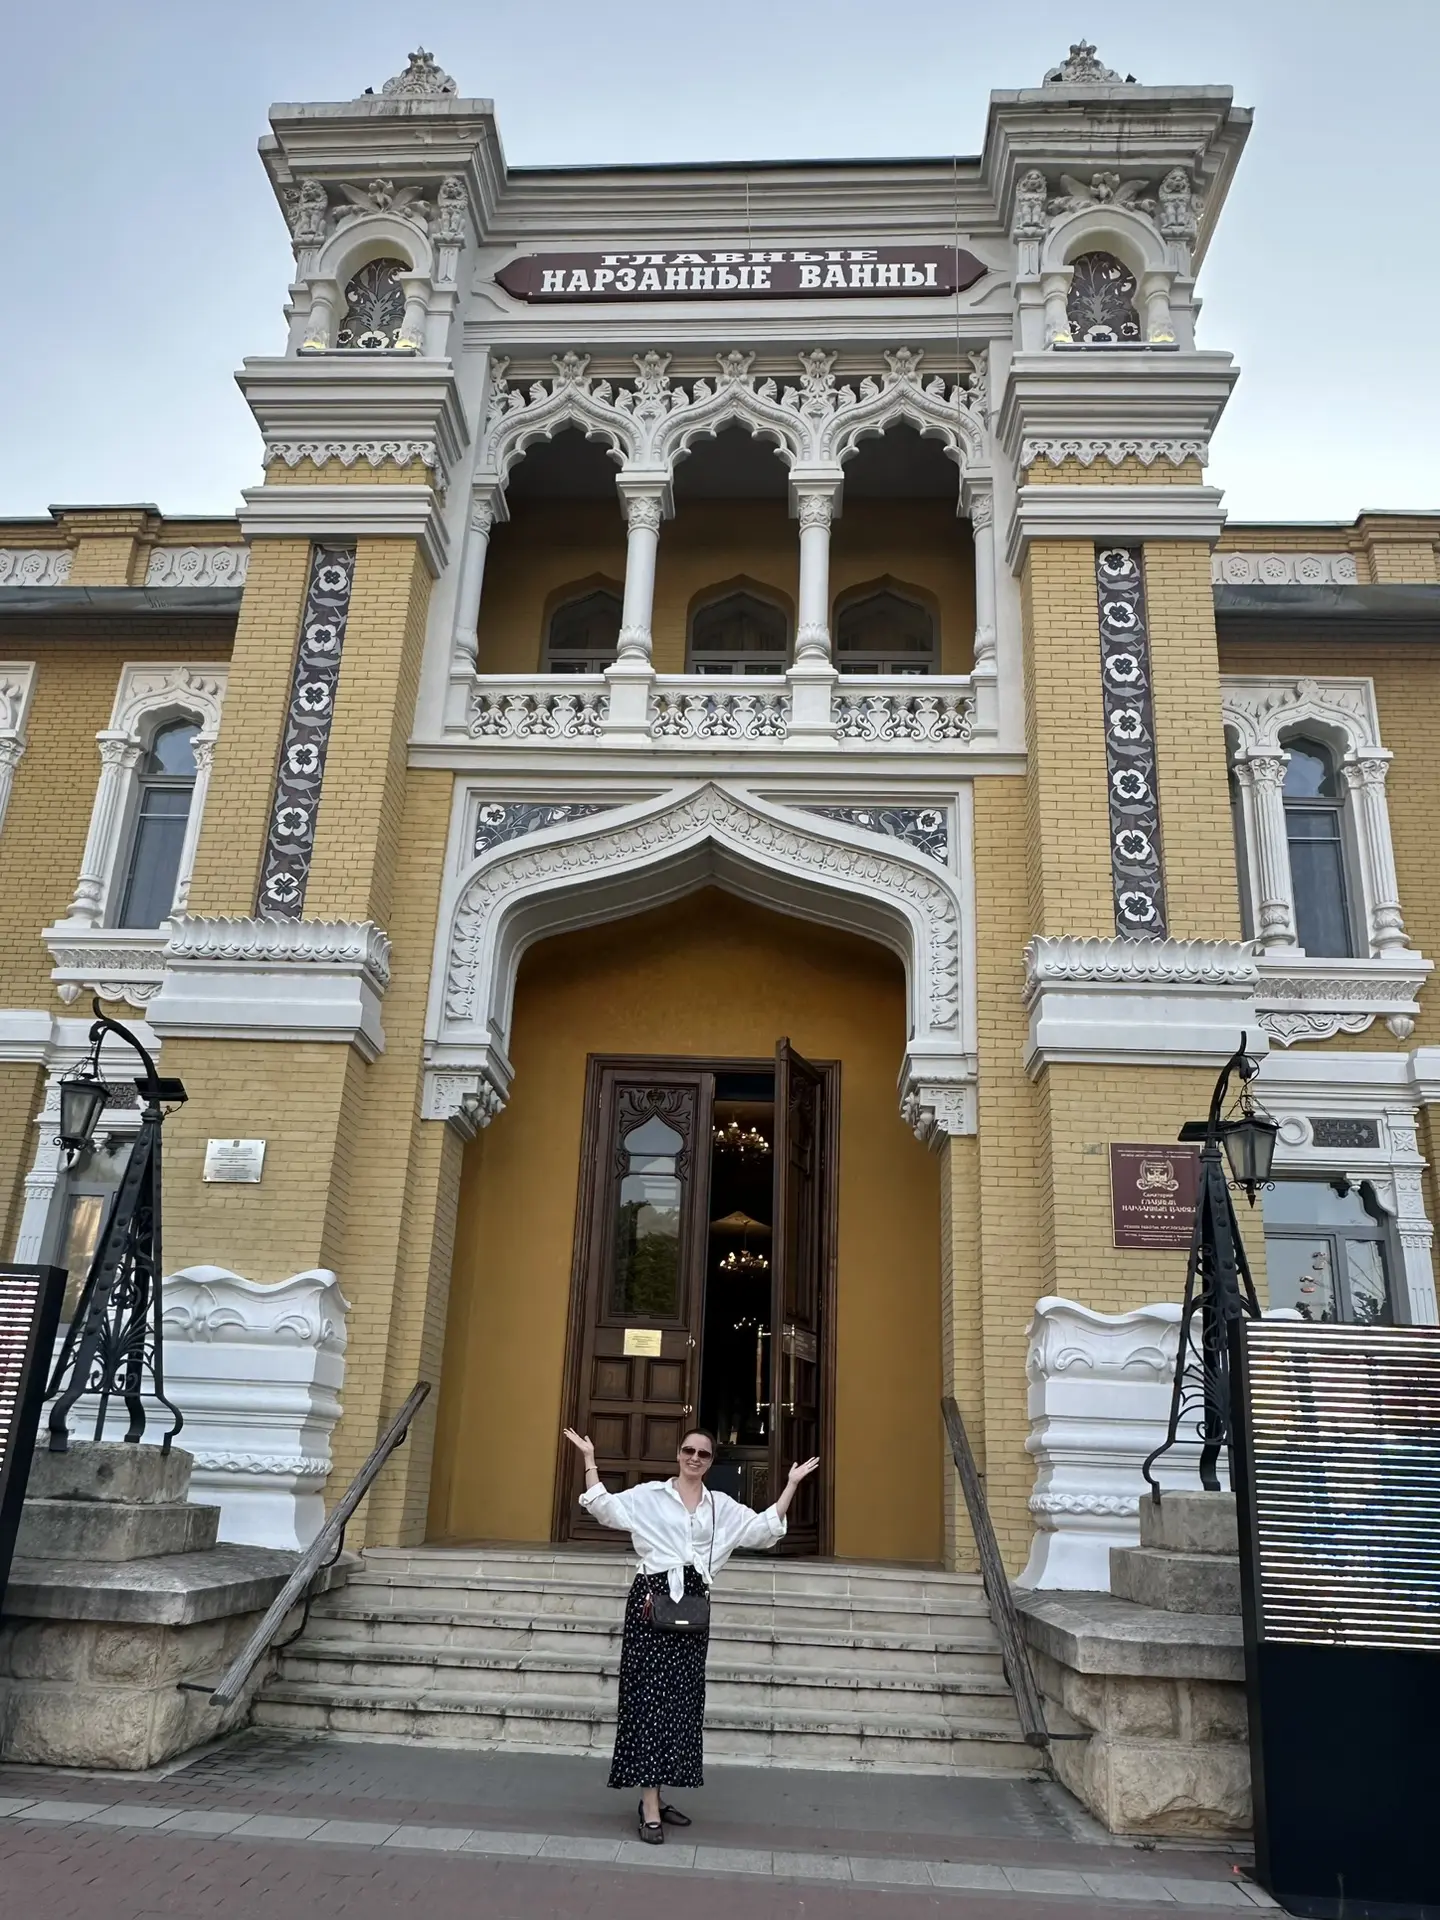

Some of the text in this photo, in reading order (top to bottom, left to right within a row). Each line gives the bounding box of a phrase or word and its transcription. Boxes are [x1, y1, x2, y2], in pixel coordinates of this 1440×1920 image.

[601, 250, 878, 266] ГЛАВНЫЕ
[540, 263, 938, 292] НАРЗАННЫЕ ВАННЫ
